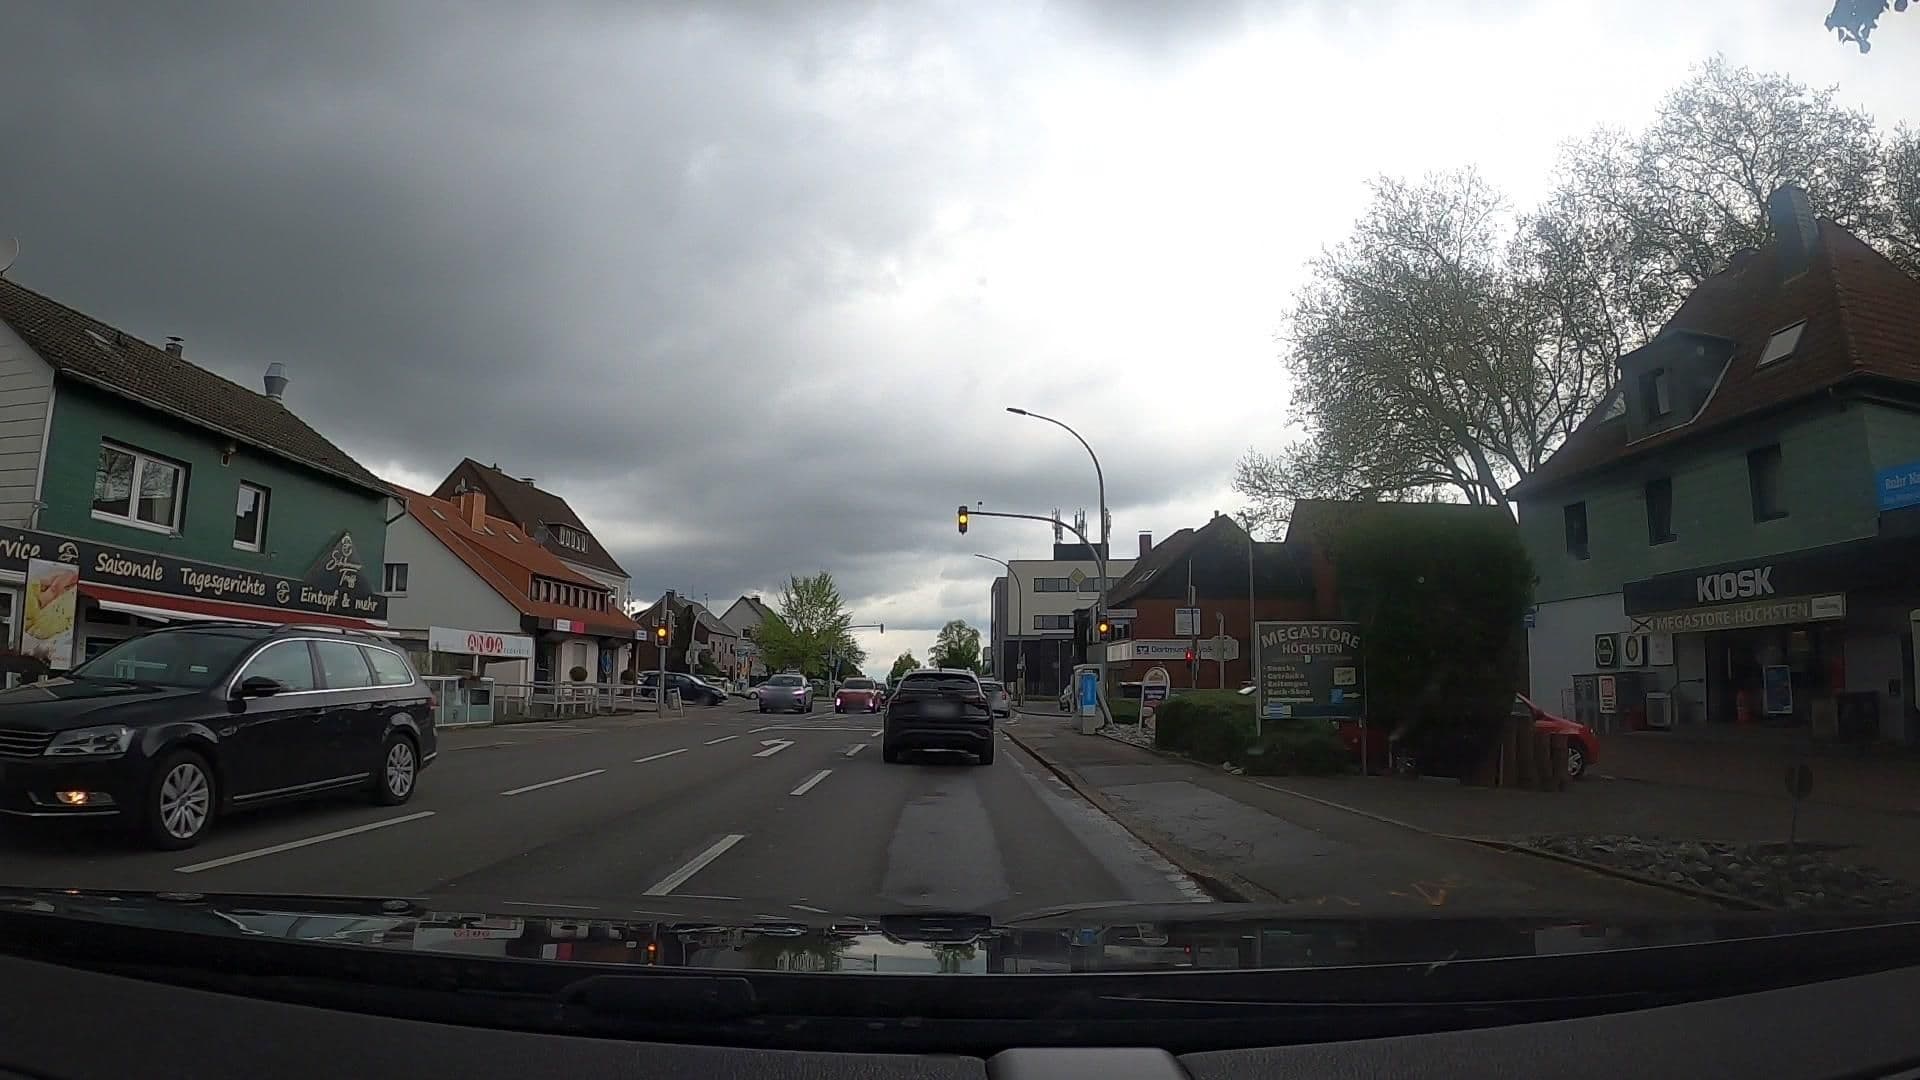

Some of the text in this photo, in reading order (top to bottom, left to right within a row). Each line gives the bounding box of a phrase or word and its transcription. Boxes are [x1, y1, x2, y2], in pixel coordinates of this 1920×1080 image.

[95, 553, 163, 581] Saisonale
[180, 568, 266, 596] Tagesgerichte
[300, 587, 339, 612] Eintopf
[342, 593, 350, 607] &
[355, 596, 378, 612] mehr
[1697, 566, 1775, 602] KIOSK
[1656, 611, 1731, 632] MEGASTORE
[1260, 626, 1361, 649] MEGASTORE
